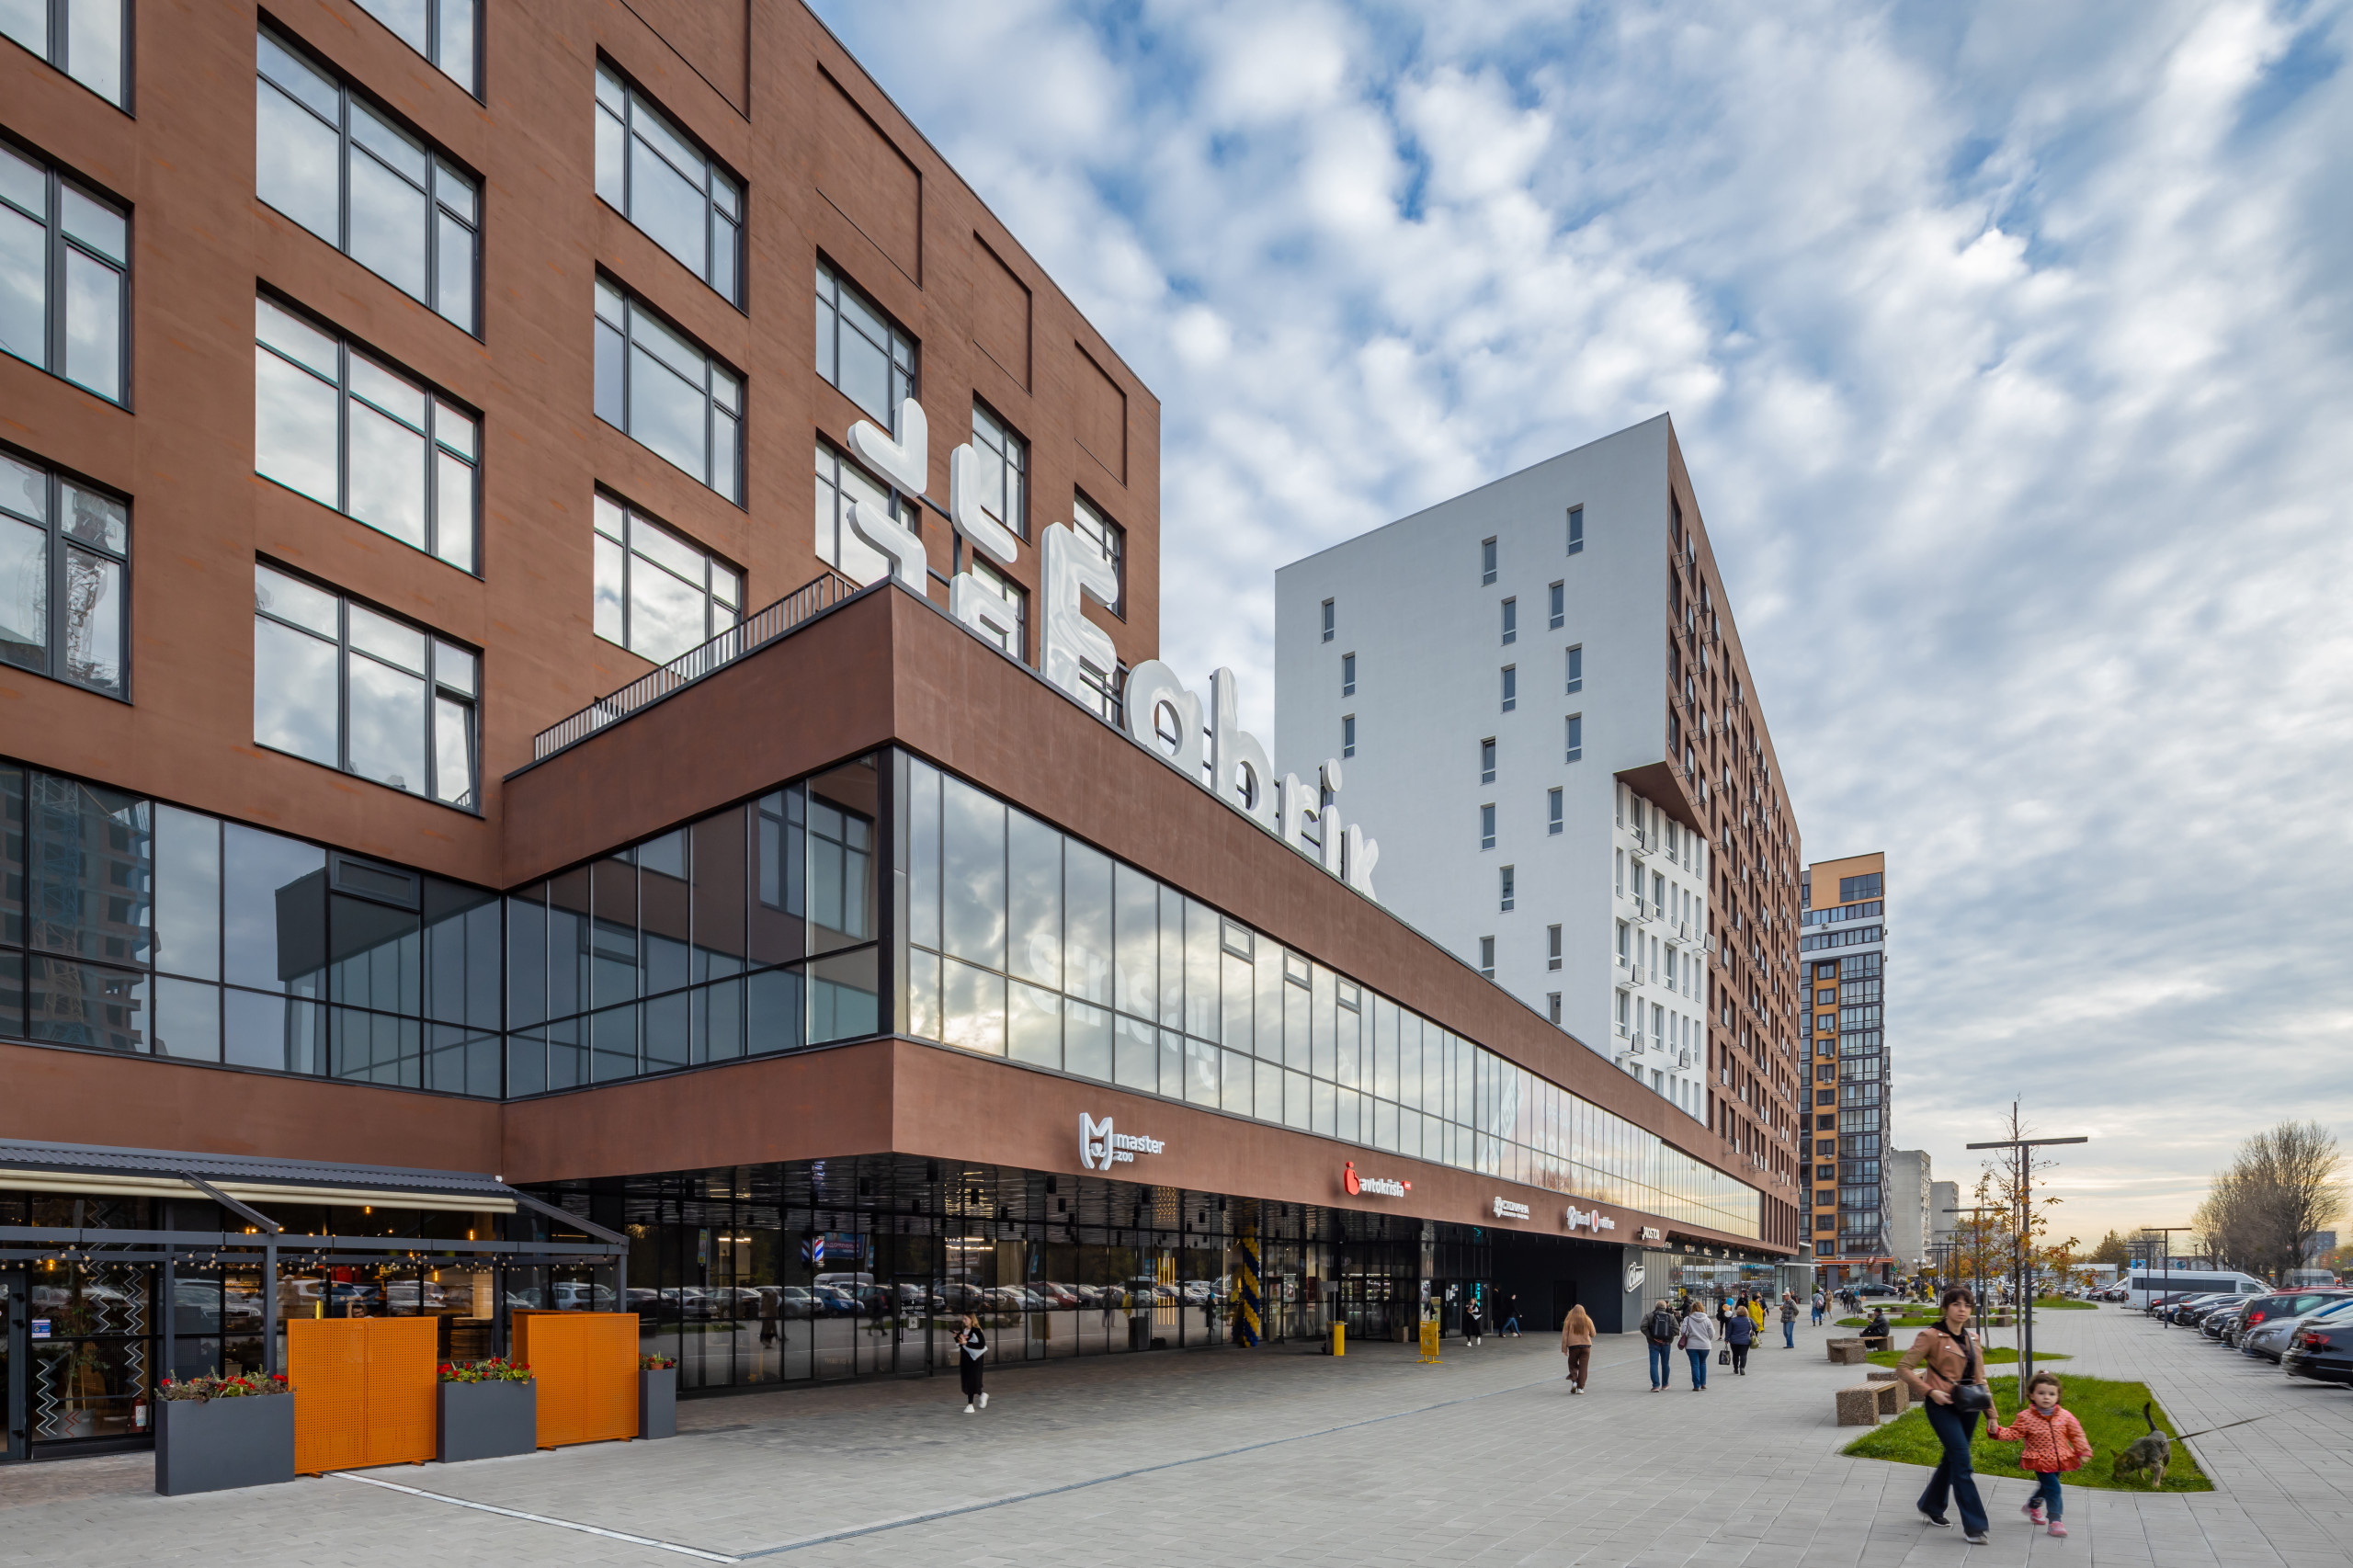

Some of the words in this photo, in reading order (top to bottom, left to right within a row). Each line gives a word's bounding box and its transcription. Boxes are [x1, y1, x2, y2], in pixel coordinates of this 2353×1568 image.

[1040, 521, 1379, 903] Fabrik
[1114, 1133, 1165, 1153] master
[1114, 1151, 1134, 1163] zoo
[1359, 1177, 1404, 1198] avtokrisla
